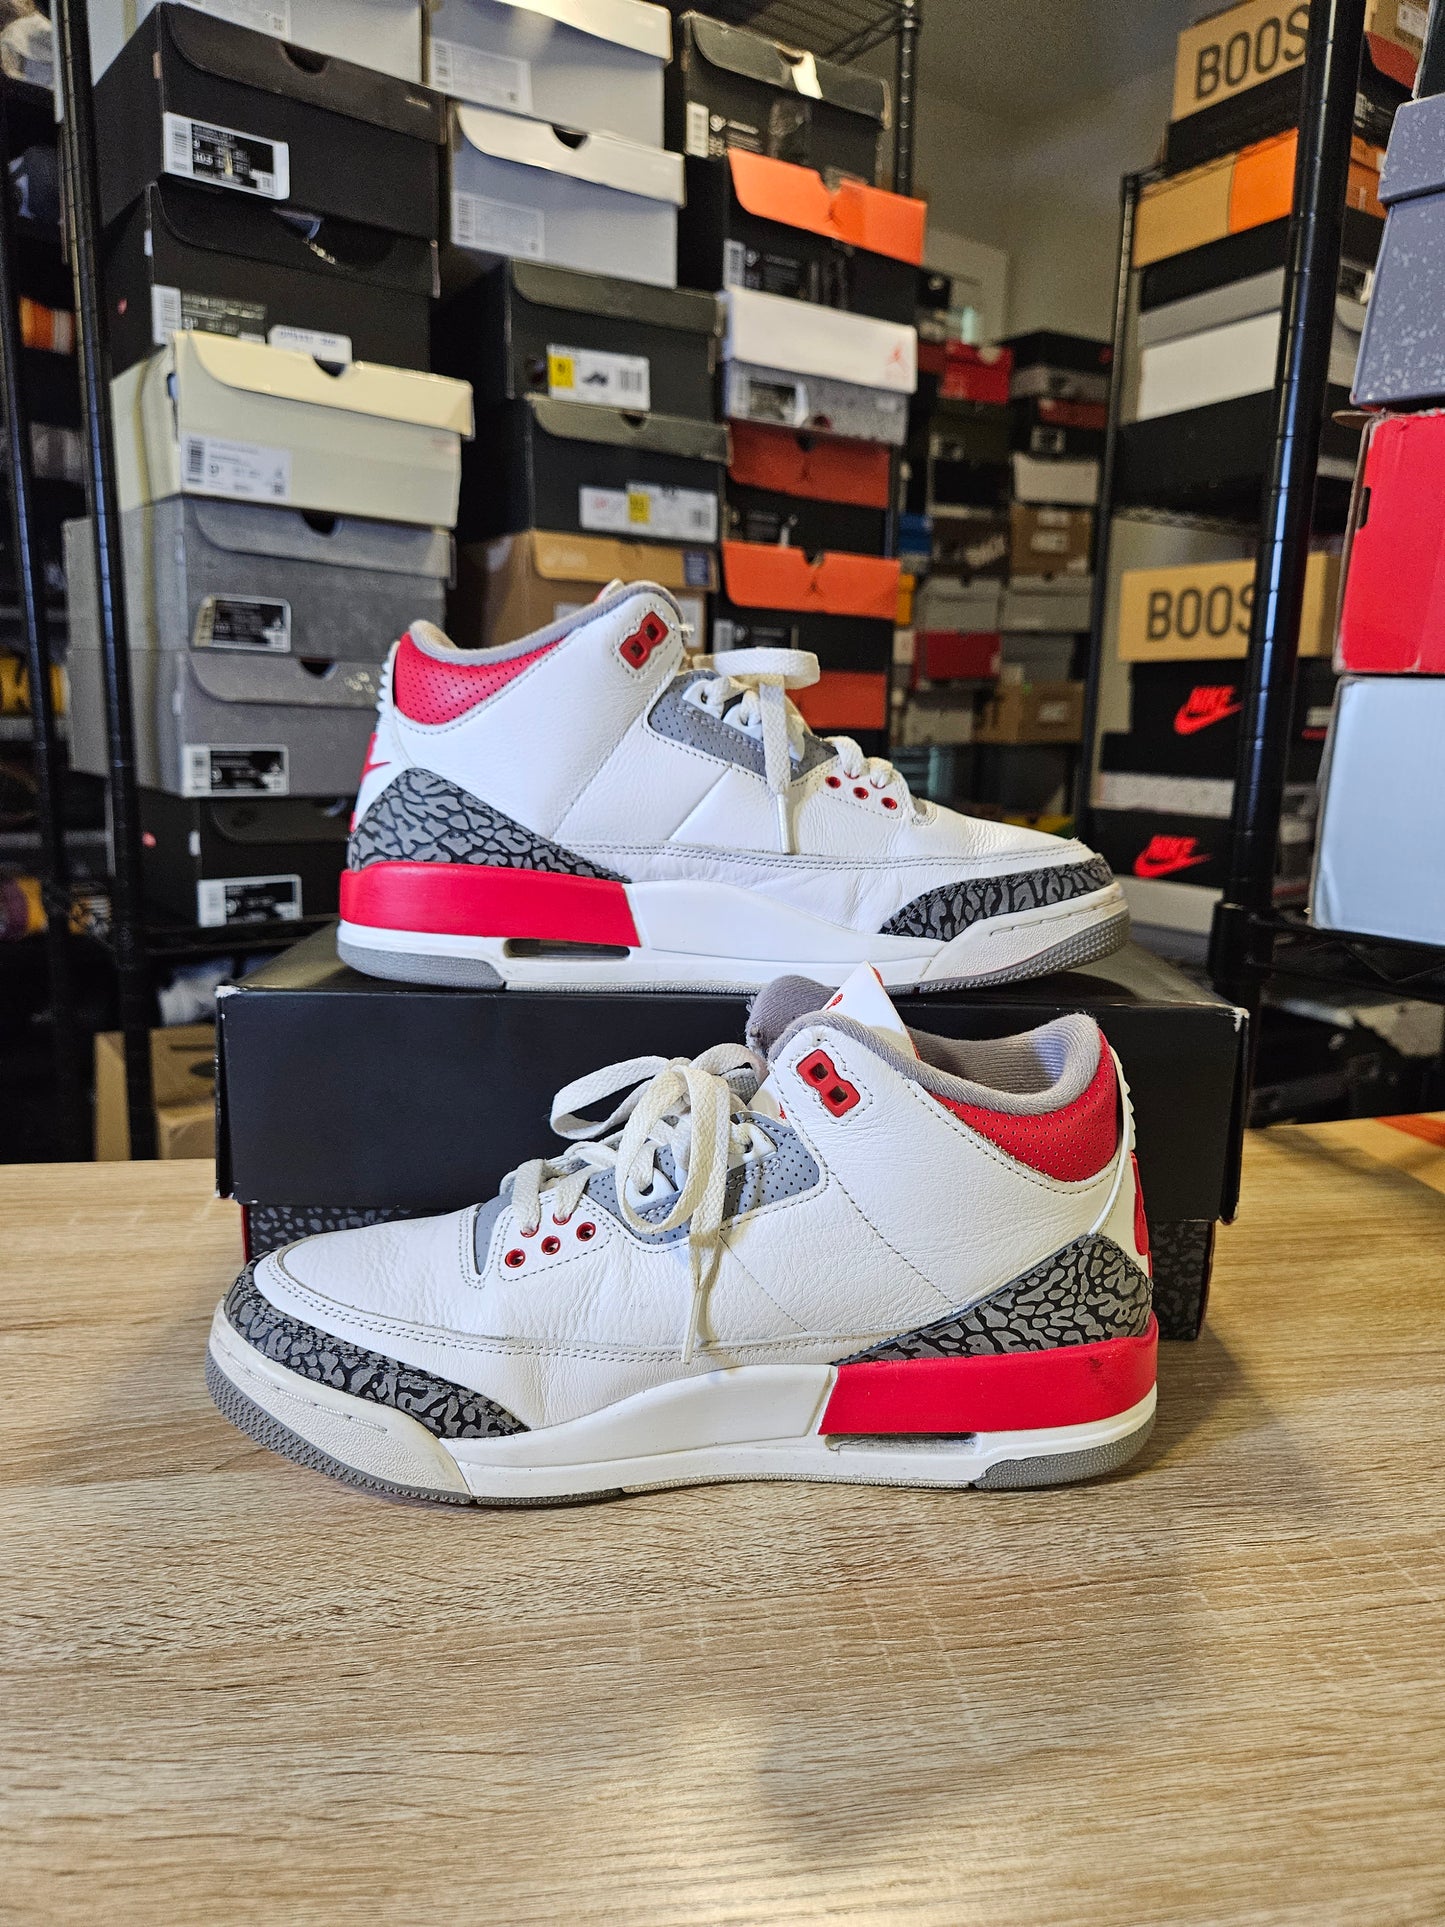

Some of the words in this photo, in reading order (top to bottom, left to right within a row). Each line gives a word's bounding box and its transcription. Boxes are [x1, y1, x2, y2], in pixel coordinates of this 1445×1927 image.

[1197, 4, 1310, 100] BOOS
[1186, 685, 1236, 714] NIKE
[1146, 834, 1199, 861] NIKE
